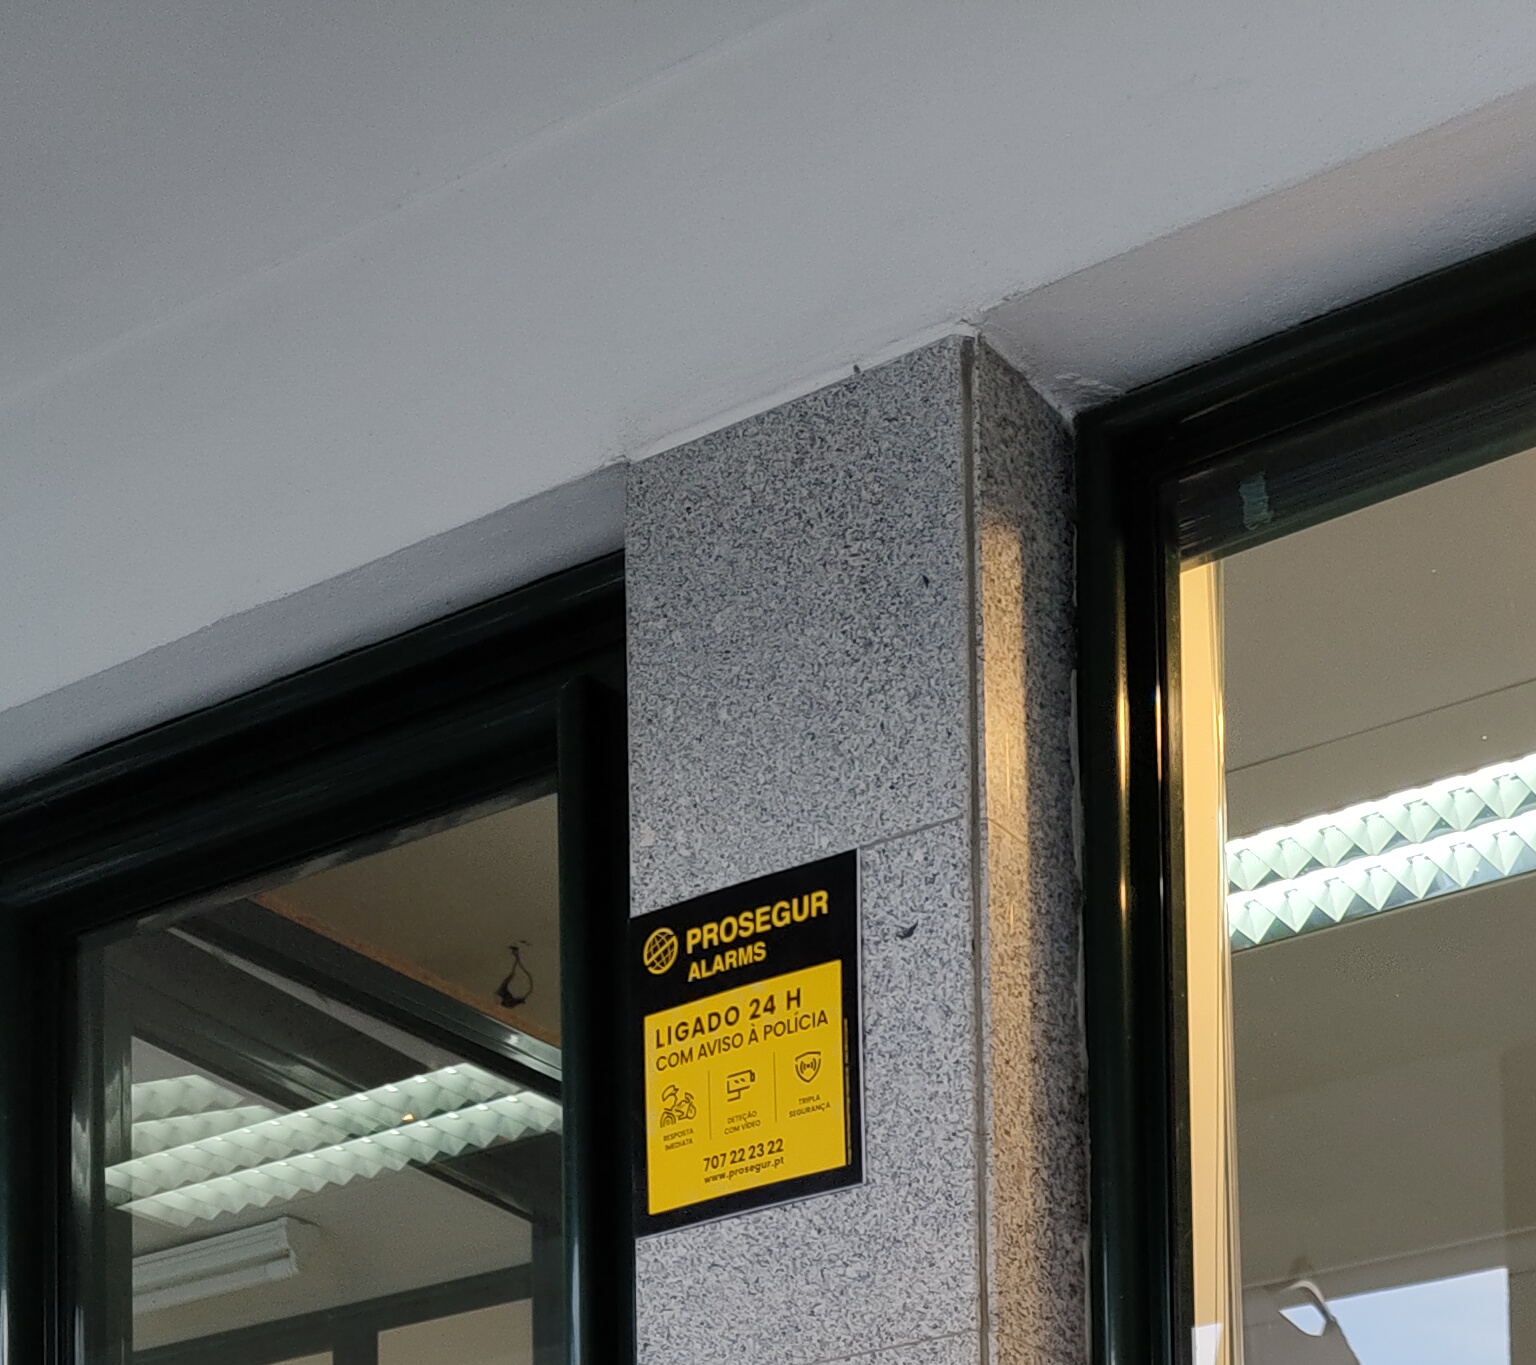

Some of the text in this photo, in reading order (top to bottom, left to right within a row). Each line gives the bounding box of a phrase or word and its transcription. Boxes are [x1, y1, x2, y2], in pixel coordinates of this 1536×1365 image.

[685, 889, 829, 955] PROSEGUR
[687, 941, 767, 982] ALARMS
[655, 987, 802, 1049] LIGADO 24 H
[655, 1009, 829, 1072] COM AVISO À POLÍCIA
[788, 1102, 831, 1118] SEGURANÇA
[703, 1138, 784, 1172] 707 22 23 22
[703, 1156, 784, 1184] www.prosegur.pt
